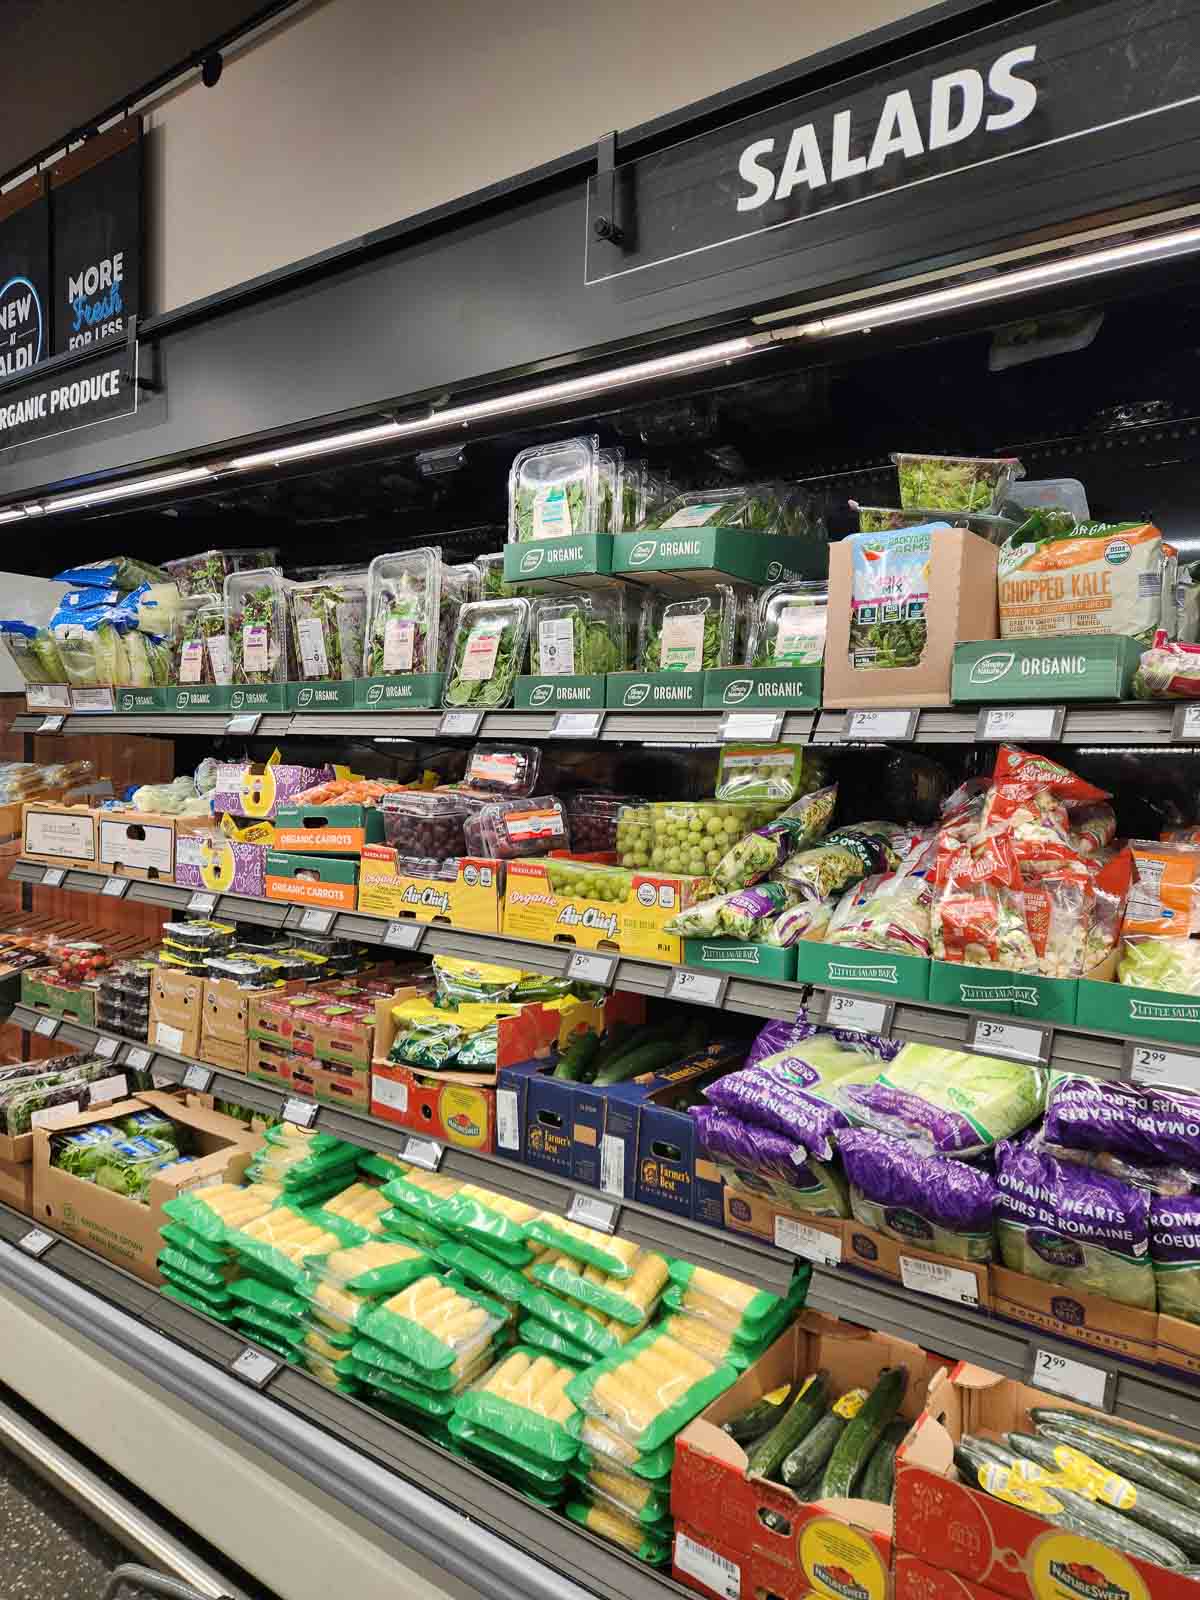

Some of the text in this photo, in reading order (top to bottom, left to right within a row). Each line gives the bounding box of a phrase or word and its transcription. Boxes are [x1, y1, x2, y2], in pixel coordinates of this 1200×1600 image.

[736, 45, 1038, 212] SALADS
[69, 252, 124, 303] MORE
[0, 293, 31, 331] NEW
[72, 280, 123, 332] Fresh
[10, 332, 17, 346] AT
[69, 331, 91, 351] FOR
[0, 343, 33, 377] ALDI
[0, 369, 120, 430] RGANIC PRODUCE
[1071, 522, 1122, 537] ORGA
[547, 547, 584, 563] ORGANIC
[659, 541, 701, 557] ORGANIC
[1000, 569, 1114, 605] CHOPPED KALE
[1021, 656, 1086, 675] ORGANIC
[315, 690, 339, 701] ORGANIC
[386, 686, 412, 697] ORGANIC
[556, 687, 591, 700] ORGANIC
[653, 687, 692, 700] ORGANIC
[757, 682, 803, 698] ORGANIC
[280, 834, 352, 845] ORGANIC CARROTS
[271, 881, 305, 896] ORGANIC
[306, 886, 345, 901] CARROTS
[832, 966, 857, 977] LITTLE
[878, 967, 892, 979] BAR
[967, 988, 992, 1000] LITTLE
[1014, 990, 1030, 1002] BAR
[1137, 1003, 1199, 1018] LITTLE SALAD
[722, 1077, 762, 1105] HEARTS
[1126, 1095, 1148, 1111] DE
[1056, 1106, 1200, 1137] OMAINE HEARTS
[544, 1129, 571, 1146] Farmer's
[543, 1143, 558, 1154] Best
[660, 1163, 691, 1184] Farmer's
[660, 1178, 675, 1191] Best
[997, 1173, 1126, 1224] OMAINE HEARTS
[1001, 1194, 1134, 1241] EURS DE ROMAINE
[1009, 1305, 1129, 1350] ROMAINE HEARTS
[814, 1564, 870, 1600] NATURESWEET
[1052, 1561, 1127, 1600] NATURESWEET
